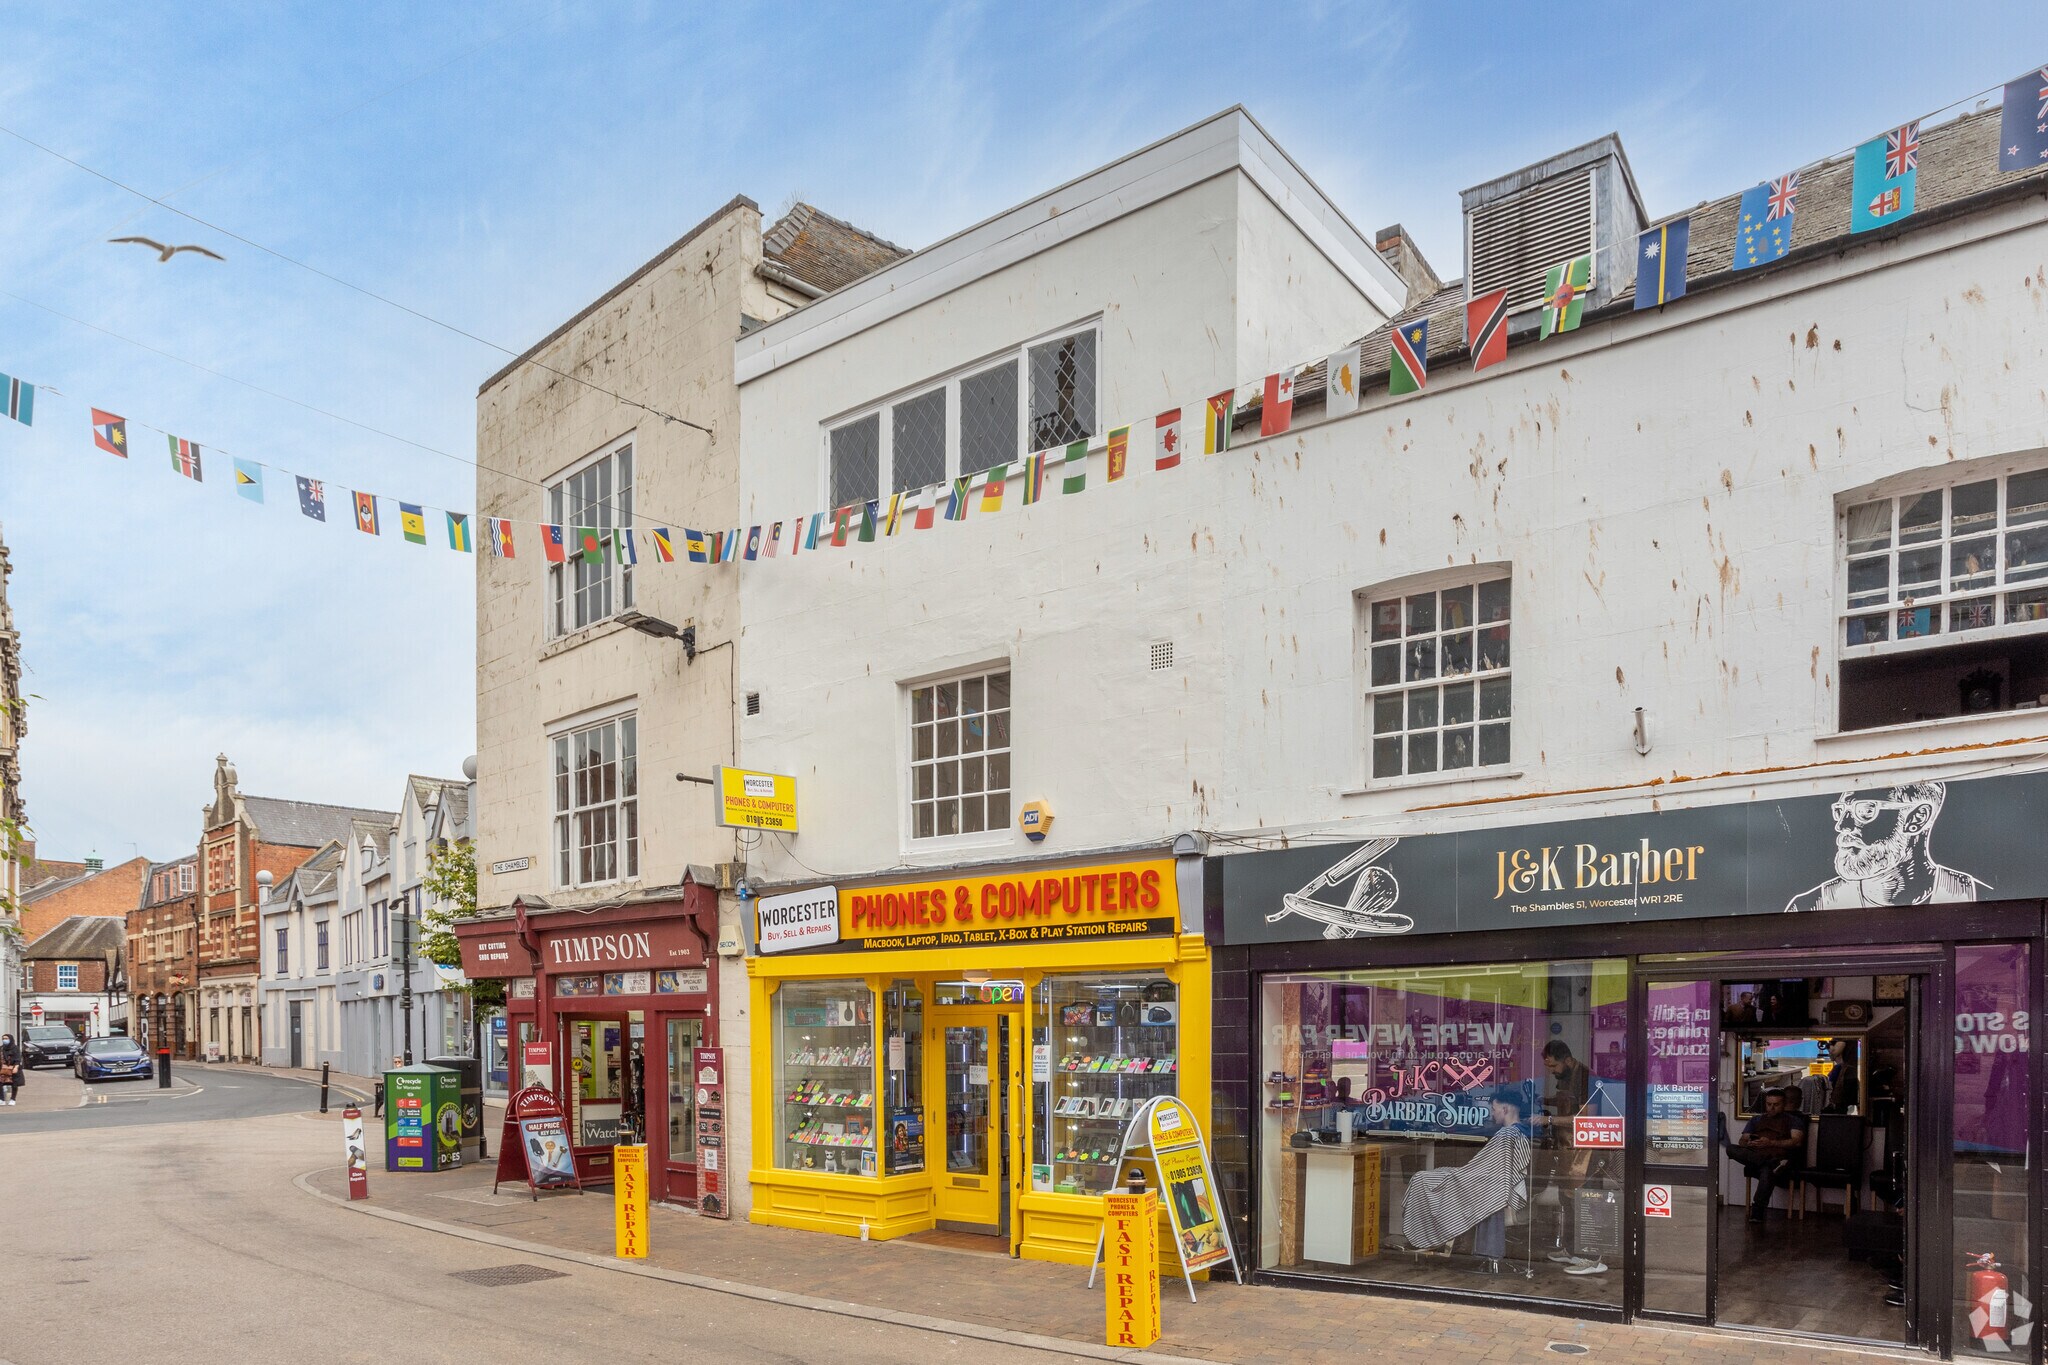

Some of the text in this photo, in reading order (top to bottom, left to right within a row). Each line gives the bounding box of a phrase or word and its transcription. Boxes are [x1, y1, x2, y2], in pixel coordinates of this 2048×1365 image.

[726, 796, 750, 808] PHONES
[752, 799, 756, 808] &
[758, 800, 794, 812] COMPUTERS
[766, 818, 782, 826] 23850
[1024, 813, 1038, 822] ADT
[504, 860, 527, 870] SHAMBLES
[1493, 838, 1704, 900] J&K Barber
[852, 870, 1160, 928] PHONES & COMPUTERS
[1510, 894, 1683, 912] The Shambles 51, Worcester WR1 2RE
[762, 900, 836, 927] WORCESTER
[768, 924, 832, 940] BUY, SELL & REPAIRS
[1030, 928, 1038, 938] &
[1041, 926, 1064, 938] PLAY
[1066, 924, 1106, 936] STATION
[1108, 921, 1148, 934] REPAIRS
[488, 942, 506, 950] CUTTING
[550, 932, 650, 964] TIMPSON
[678, 948, 690, 956] 1903
[490, 952, 508, 960] REPAIRS
[980, 986, 1022, 1004] open
[1388, 1060, 1440, 1097] J&K
[1653, 1084, 1704, 1092] J&K Barber
[520, 1093, 556, 1108] TIMPSON
[1160, 1112, 1178, 1122] WORCESTER
[1576, 1131, 1622, 1142] OPEN
[1170, 1164, 1202, 1180] 01905 23850
[624, 1164, 636, 1255] FAST REPAIR
[1116, 1220, 1136, 1344] FAST REPAIR
[1149, 1270, 1158, 1341] REPAIR
